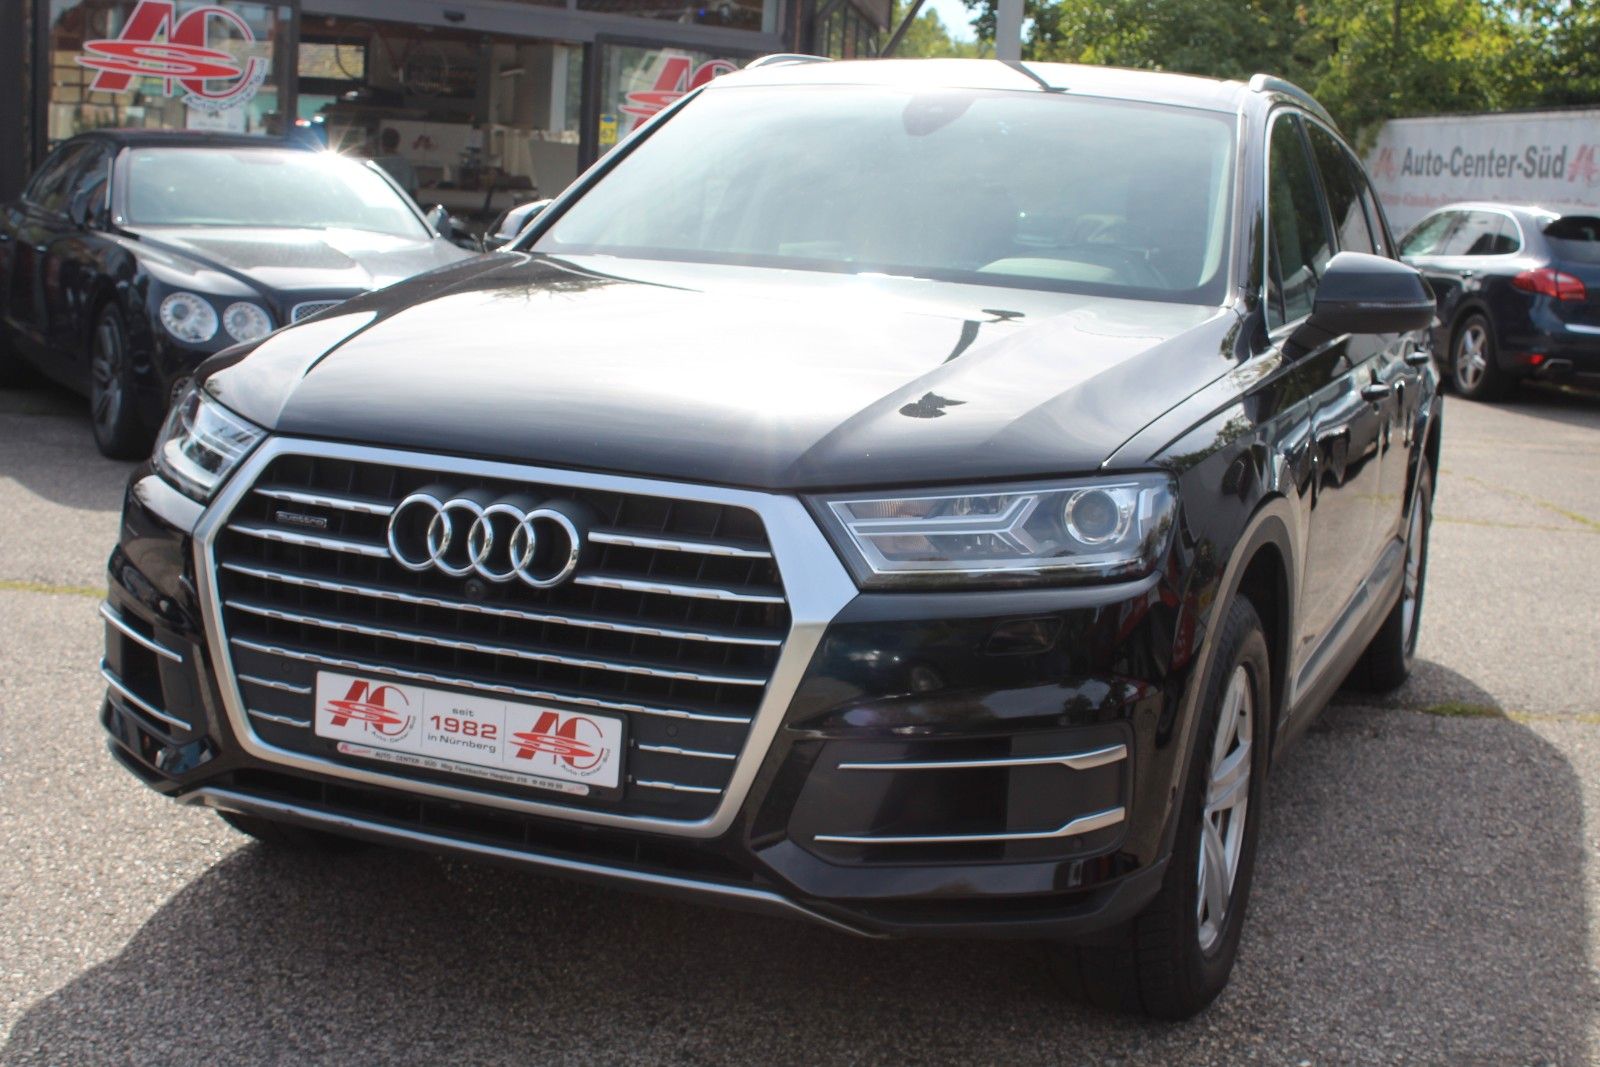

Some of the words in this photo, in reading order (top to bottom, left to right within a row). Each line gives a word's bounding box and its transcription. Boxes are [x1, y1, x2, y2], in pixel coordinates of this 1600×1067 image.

[1401, 145, 1567, 179] Auto-Center-Süd
[452, 707, 475, 717] seit
[430, 715, 497, 740] 1982
[427, 732, 437, 742] in
[439, 734, 497, 754] Nürnberg
